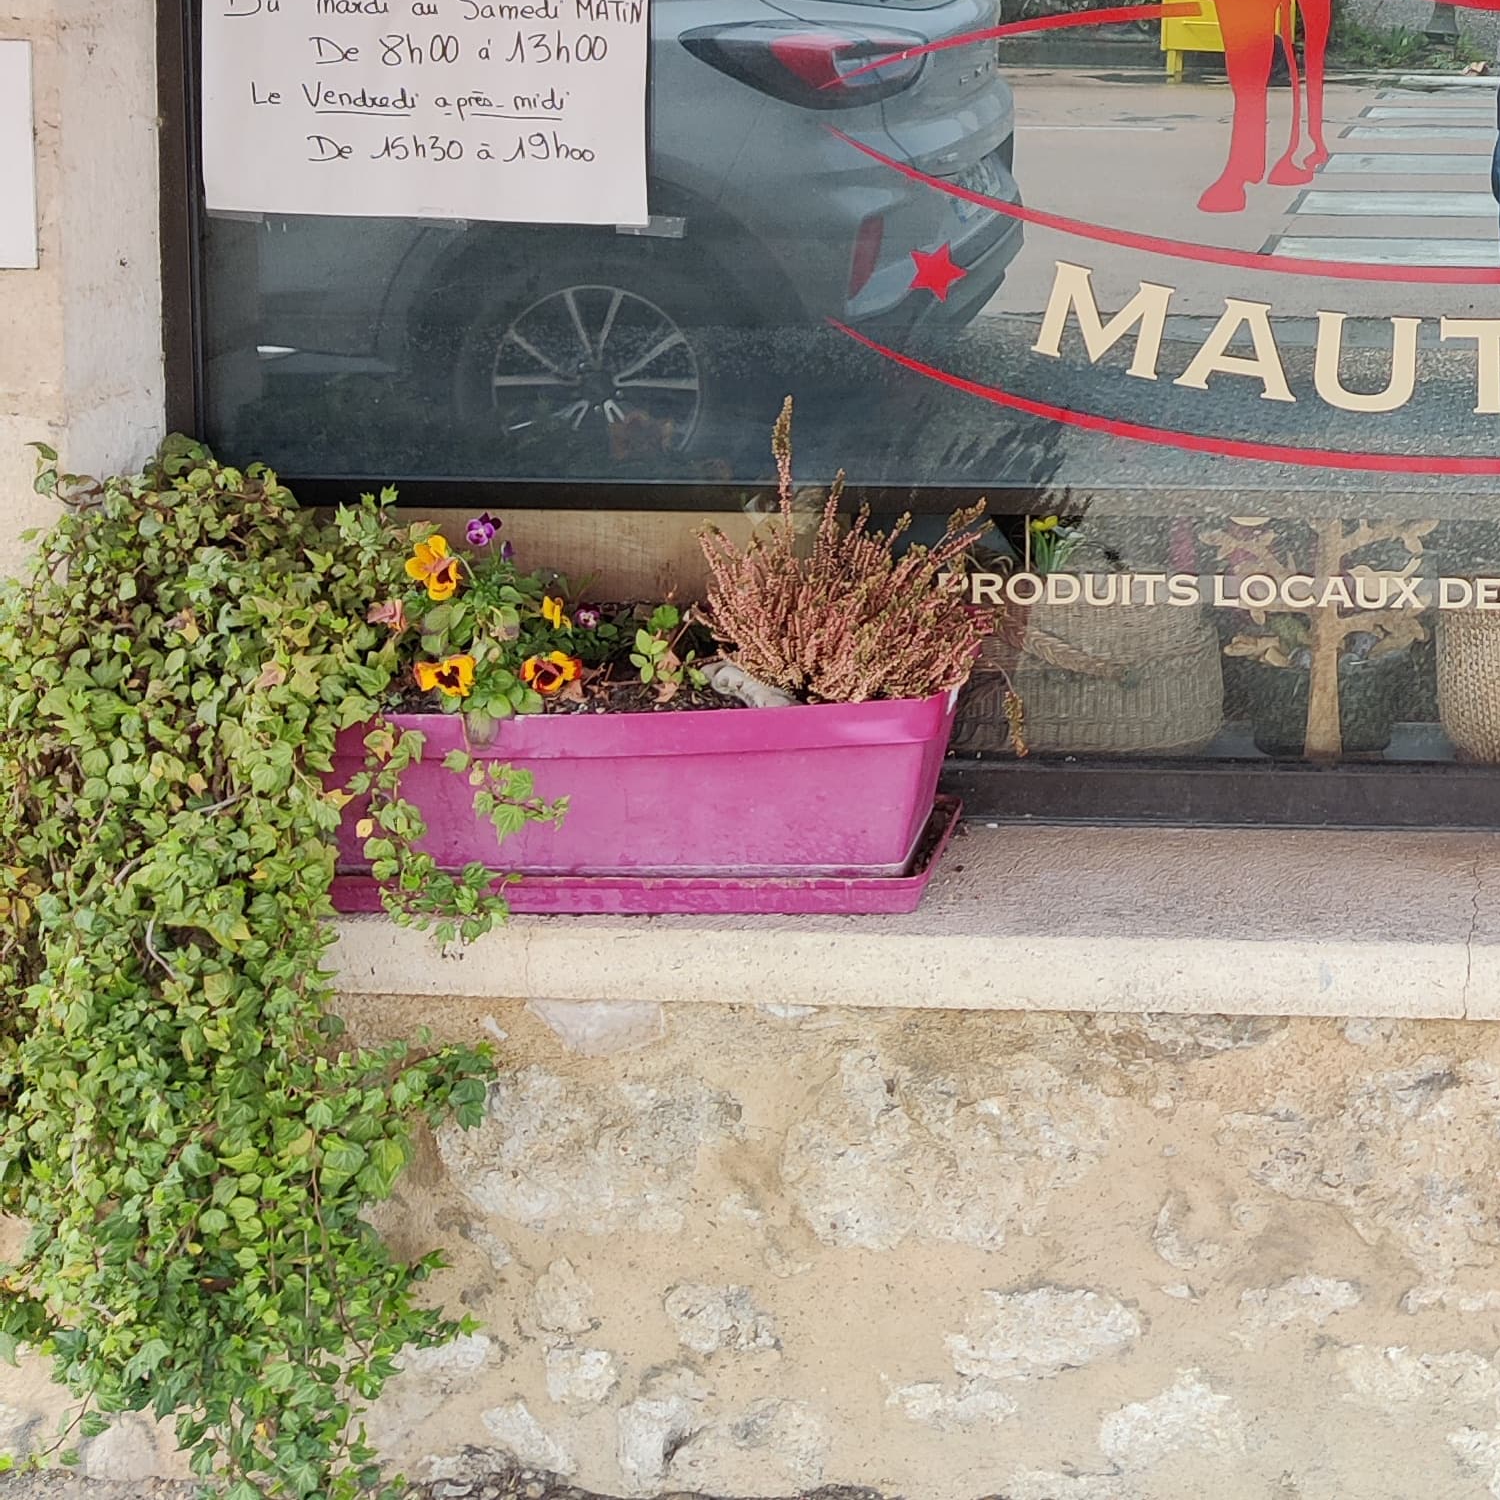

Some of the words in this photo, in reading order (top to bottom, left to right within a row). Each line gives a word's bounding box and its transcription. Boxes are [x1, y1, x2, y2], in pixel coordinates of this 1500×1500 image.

[411, 2, 439, 16] au
[309, 36, 360, 65] De
[379, 33, 459, 66] 8h00
[505, 30, 608, 64] 13h00
[251, 81, 281, 106] Le
[302, 81, 420, 110] Vendredi
[306, 135, 353, 163] De
[371, 135, 463, 163] 15h30
[503, 131, 595, 164] 19h00
[1212, 574, 1425, 609] LOCAUX
